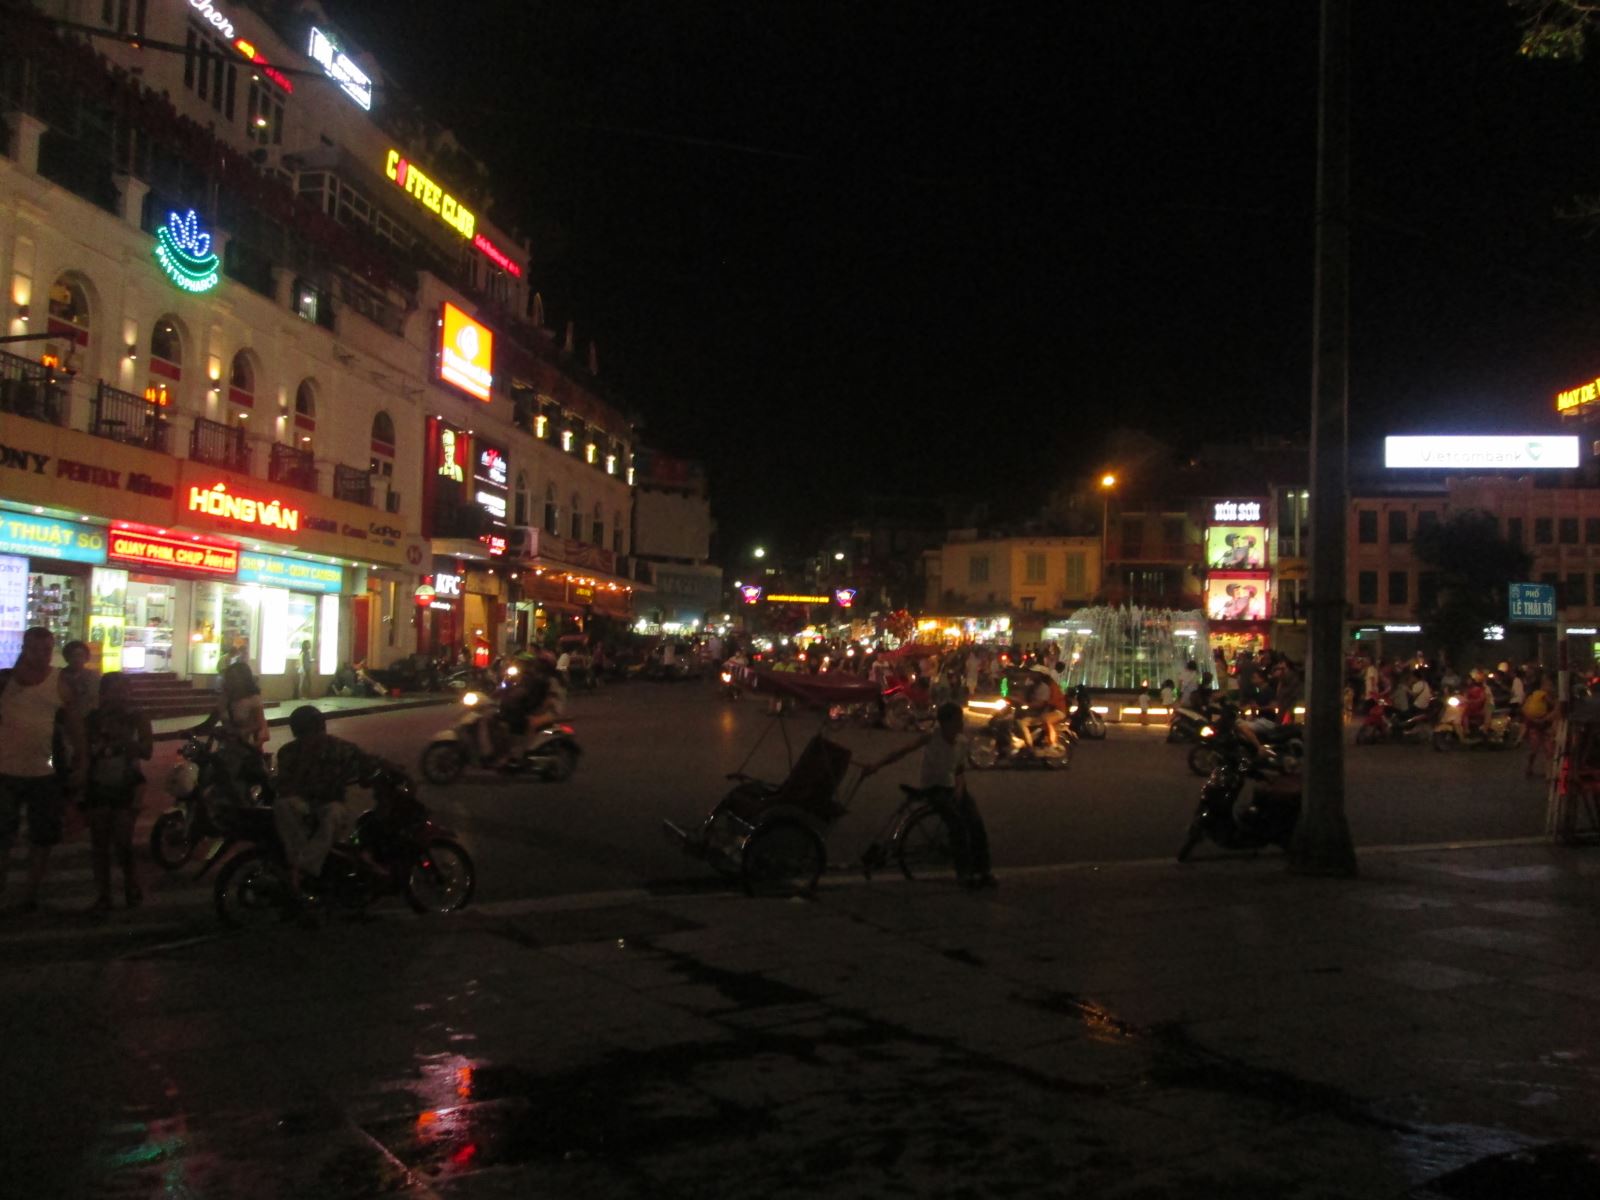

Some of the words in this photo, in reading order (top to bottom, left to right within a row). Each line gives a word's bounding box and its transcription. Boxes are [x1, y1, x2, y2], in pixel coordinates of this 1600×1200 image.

[386, 149, 443, 215] COFFEE
[1421, 450, 1523, 463] Vietcombank
[114, 539, 147, 556] QUAY
[435, 573, 461, 595] KFC
